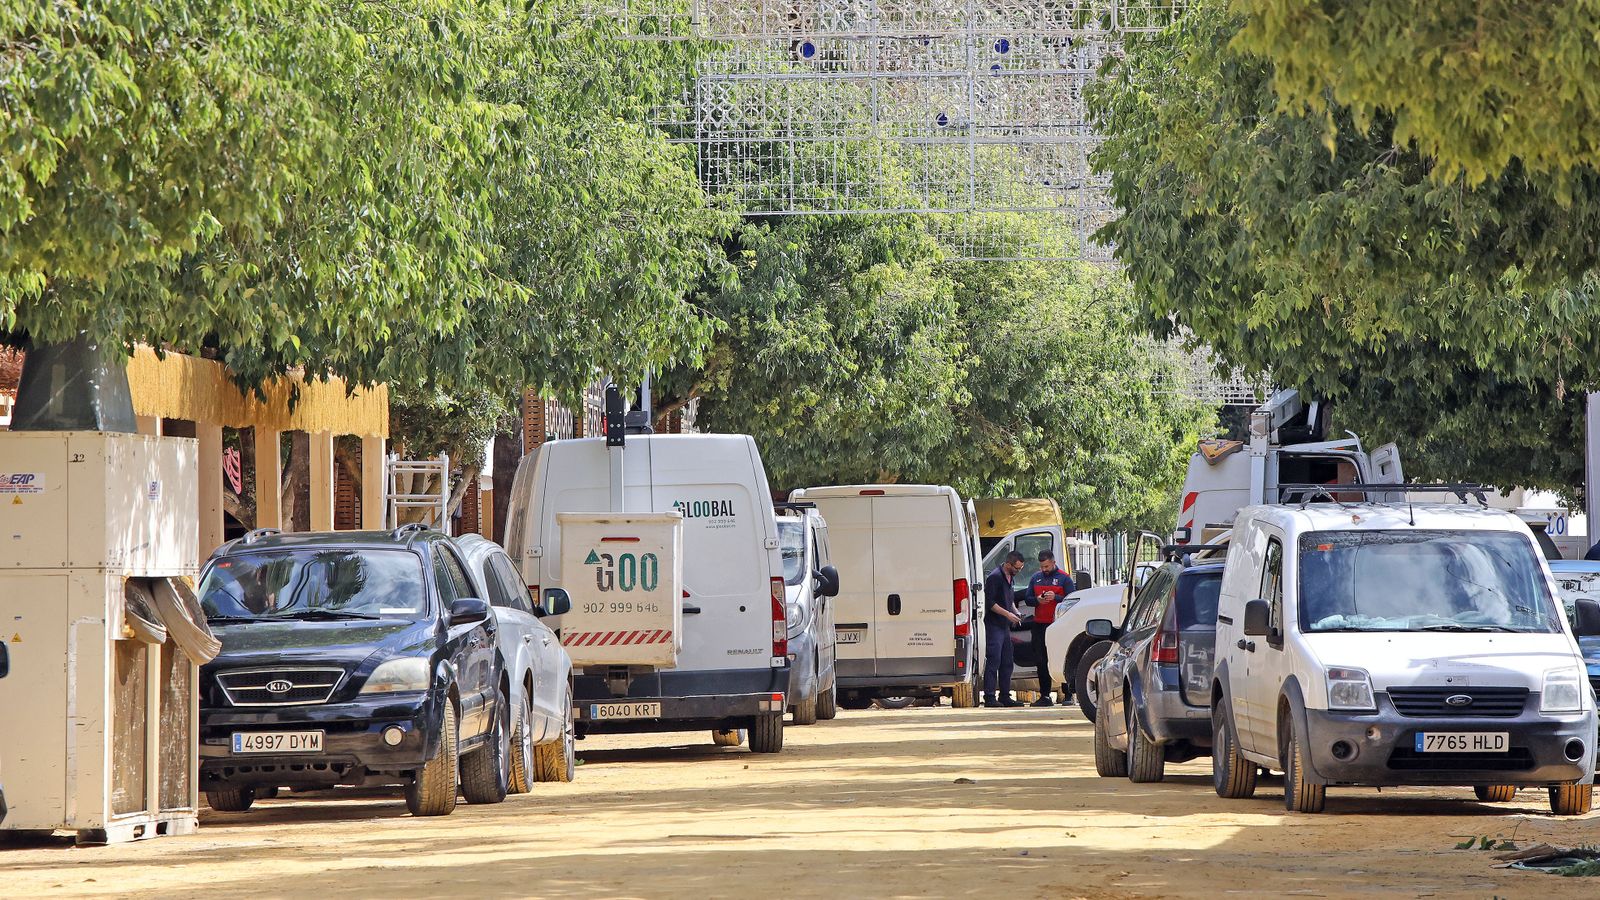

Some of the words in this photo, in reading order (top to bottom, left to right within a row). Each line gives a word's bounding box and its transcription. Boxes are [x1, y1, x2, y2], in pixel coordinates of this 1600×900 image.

[9, 473, 35, 484] EAP
[678, 500, 736, 518] GLOOBAL
[596, 553, 658, 592] GOO
[583, 603, 604, 613] 902
[610, 603, 632, 613] 999
[636, 602, 658, 613] 646
[842, 632, 858, 641] JVX
[600, 705, 631, 717] 6040
[634, 703, 657, 716] KRT
[245, 735, 284, 749] 4997
[290, 734, 318, 749] DYM
[1426, 735, 1467, 749] 7765
[1473, 735, 1504, 749] HLD
